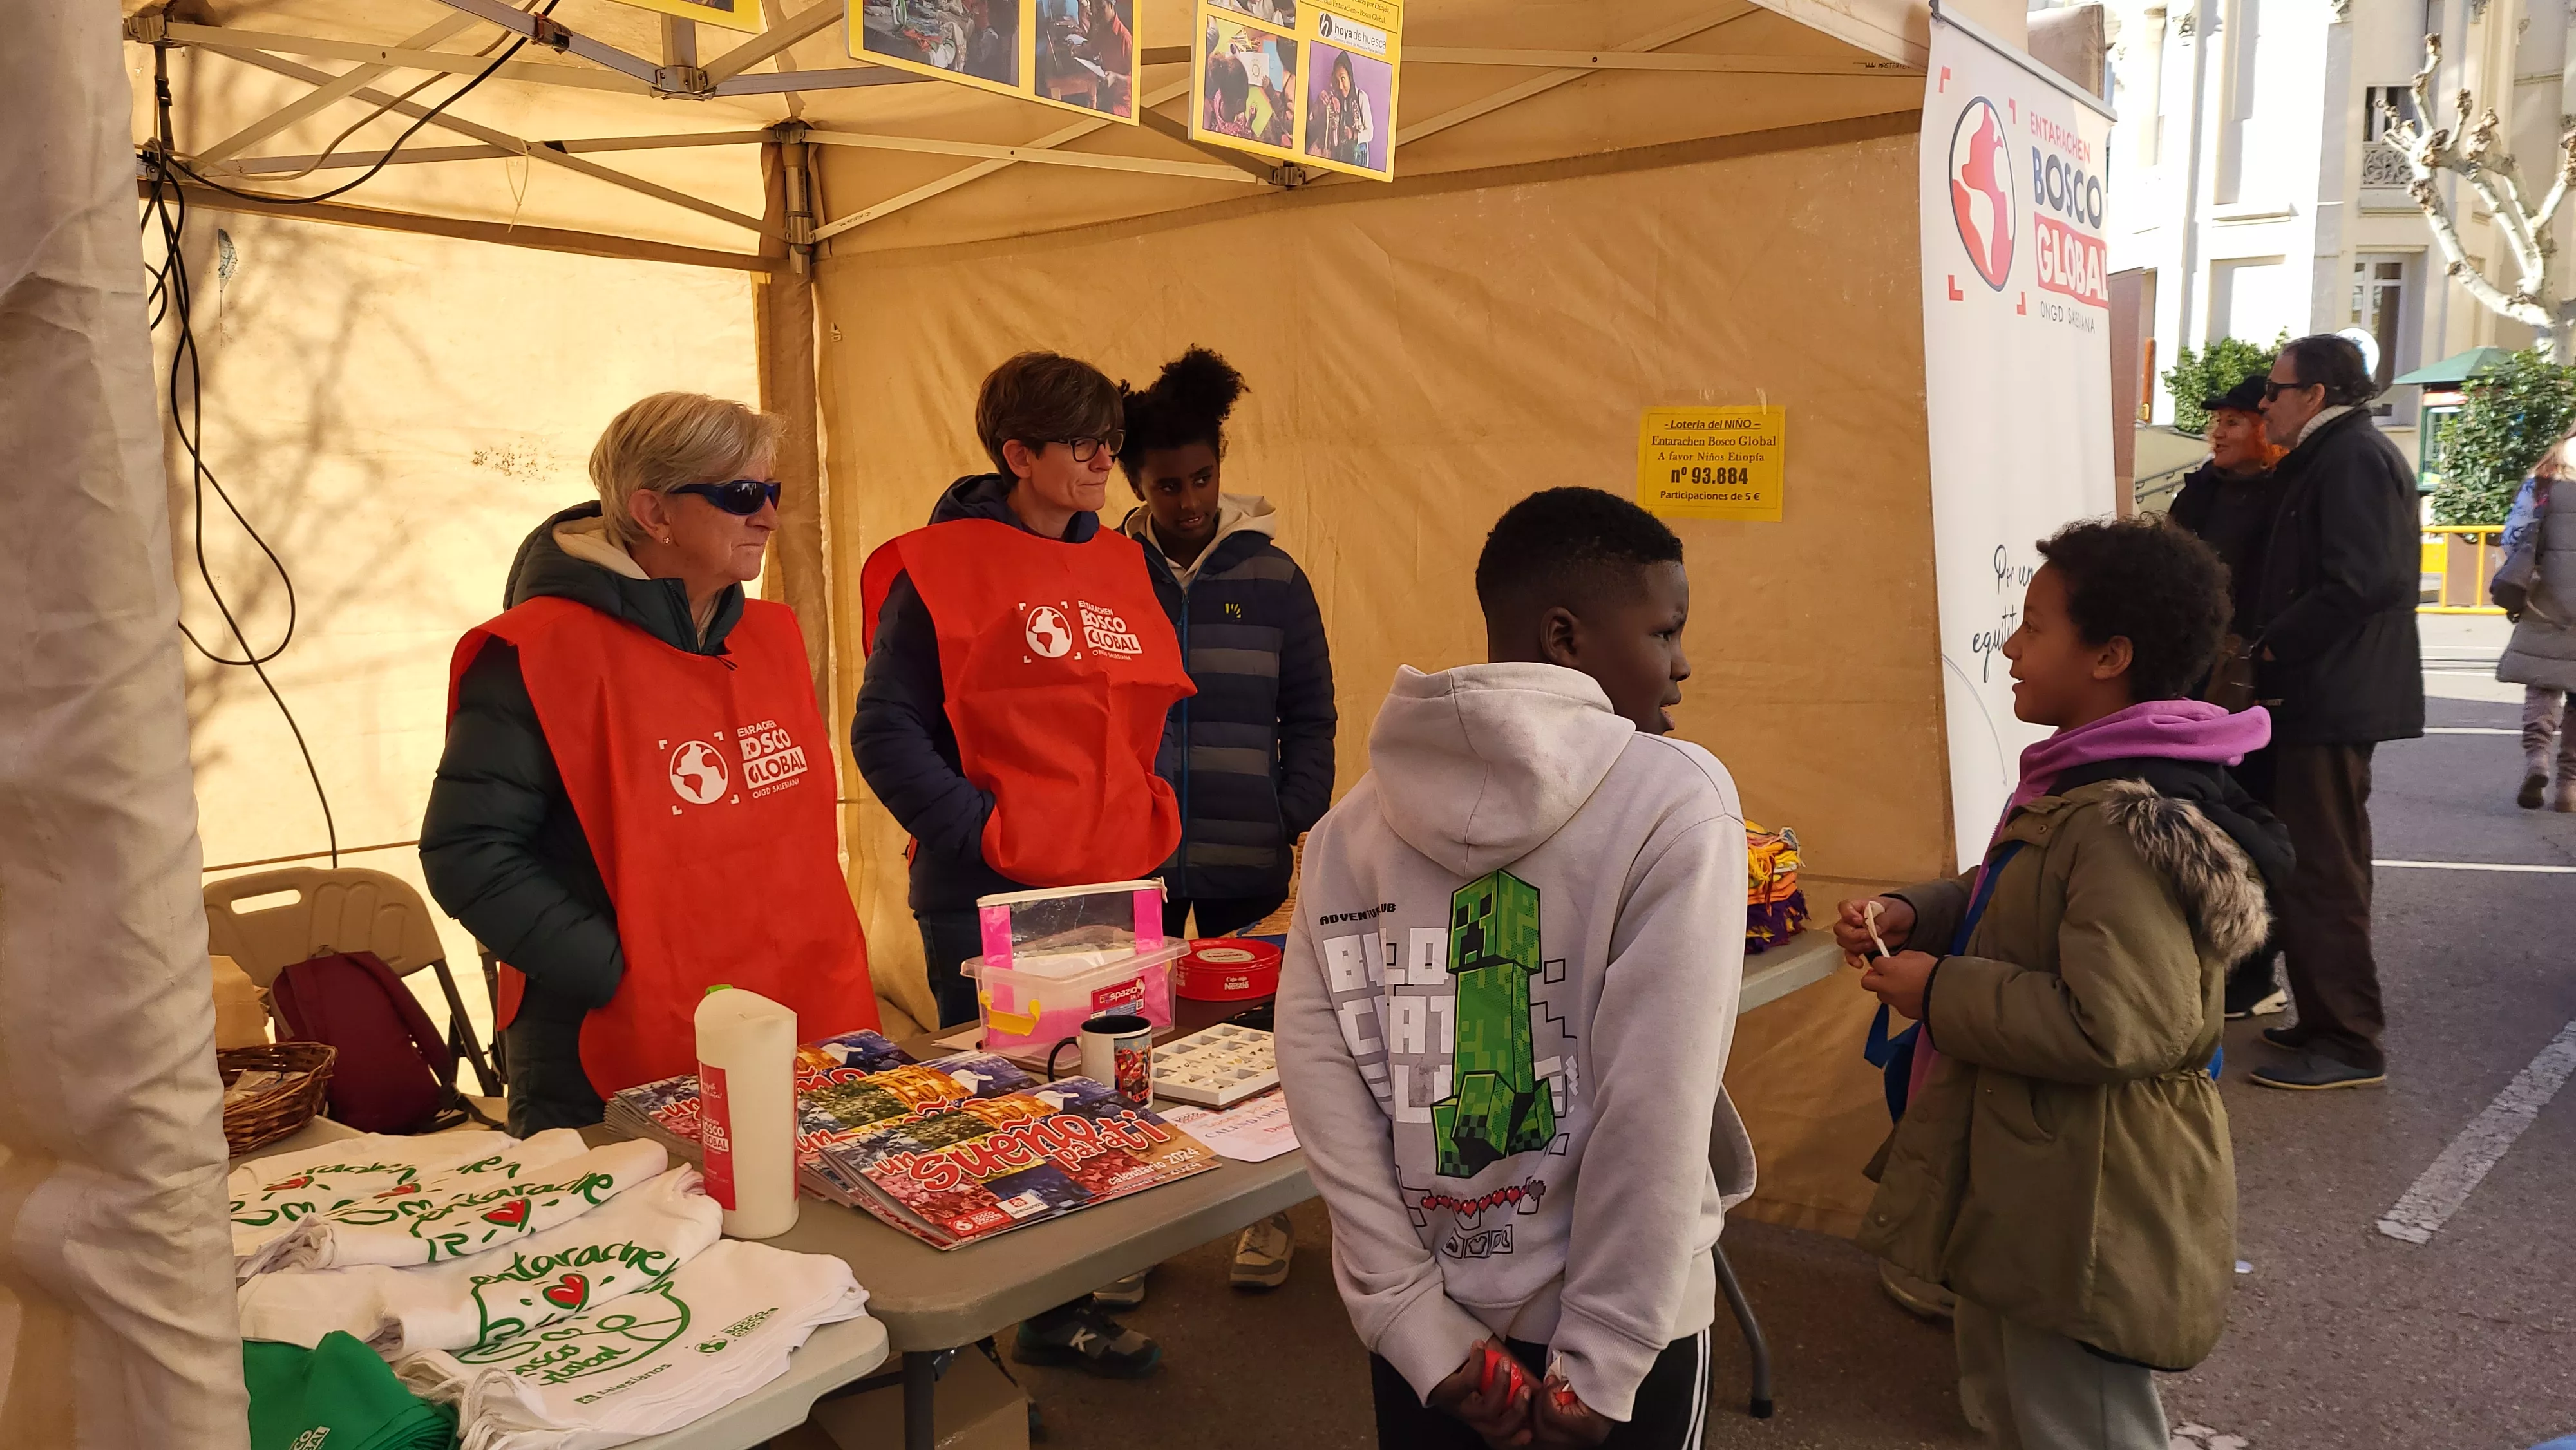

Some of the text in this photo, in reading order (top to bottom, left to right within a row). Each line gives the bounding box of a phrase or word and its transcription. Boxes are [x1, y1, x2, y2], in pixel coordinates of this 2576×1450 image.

[1359, 9, 1372, 19] Bosco
[1335, 23, 1352, 39] hoya
[1353, 30, 1362, 41] de
[1363, 33, 1386, 50] huesca
[2031, 111, 2091, 164] ENTARACHEN
[2032, 145, 2103, 229] BOSCO
[2036, 224, 2108, 301] GLOBAL
[2040, 301, 2064, 322] ONGD
[1708, 420, 1723, 429] del
[1725, 417, 1752, 428] NIÑO
[1651, 436, 1776, 446] Entarachen Bosco Global
[1658, 451, 1765, 463] A favor Niños Etiopía
[1692, 467, 1748, 484] 93.884
[1660, 491, 1728, 502] Participaciones
[1731, 492, 1742, 500] de
[1754, 493, 1760, 501] €
[1080, 608, 1127, 634] BOSCO
[1088, 628, 1139, 652] GLOBAL
[1096, 1109, 1172, 1151] ti
[873, 1149, 919, 1176] un
[1108, 1147, 1201, 1186] calendario 2024
[415, 1171, 614, 1221] entarache
[470, 1240, 673, 1284] entarache
